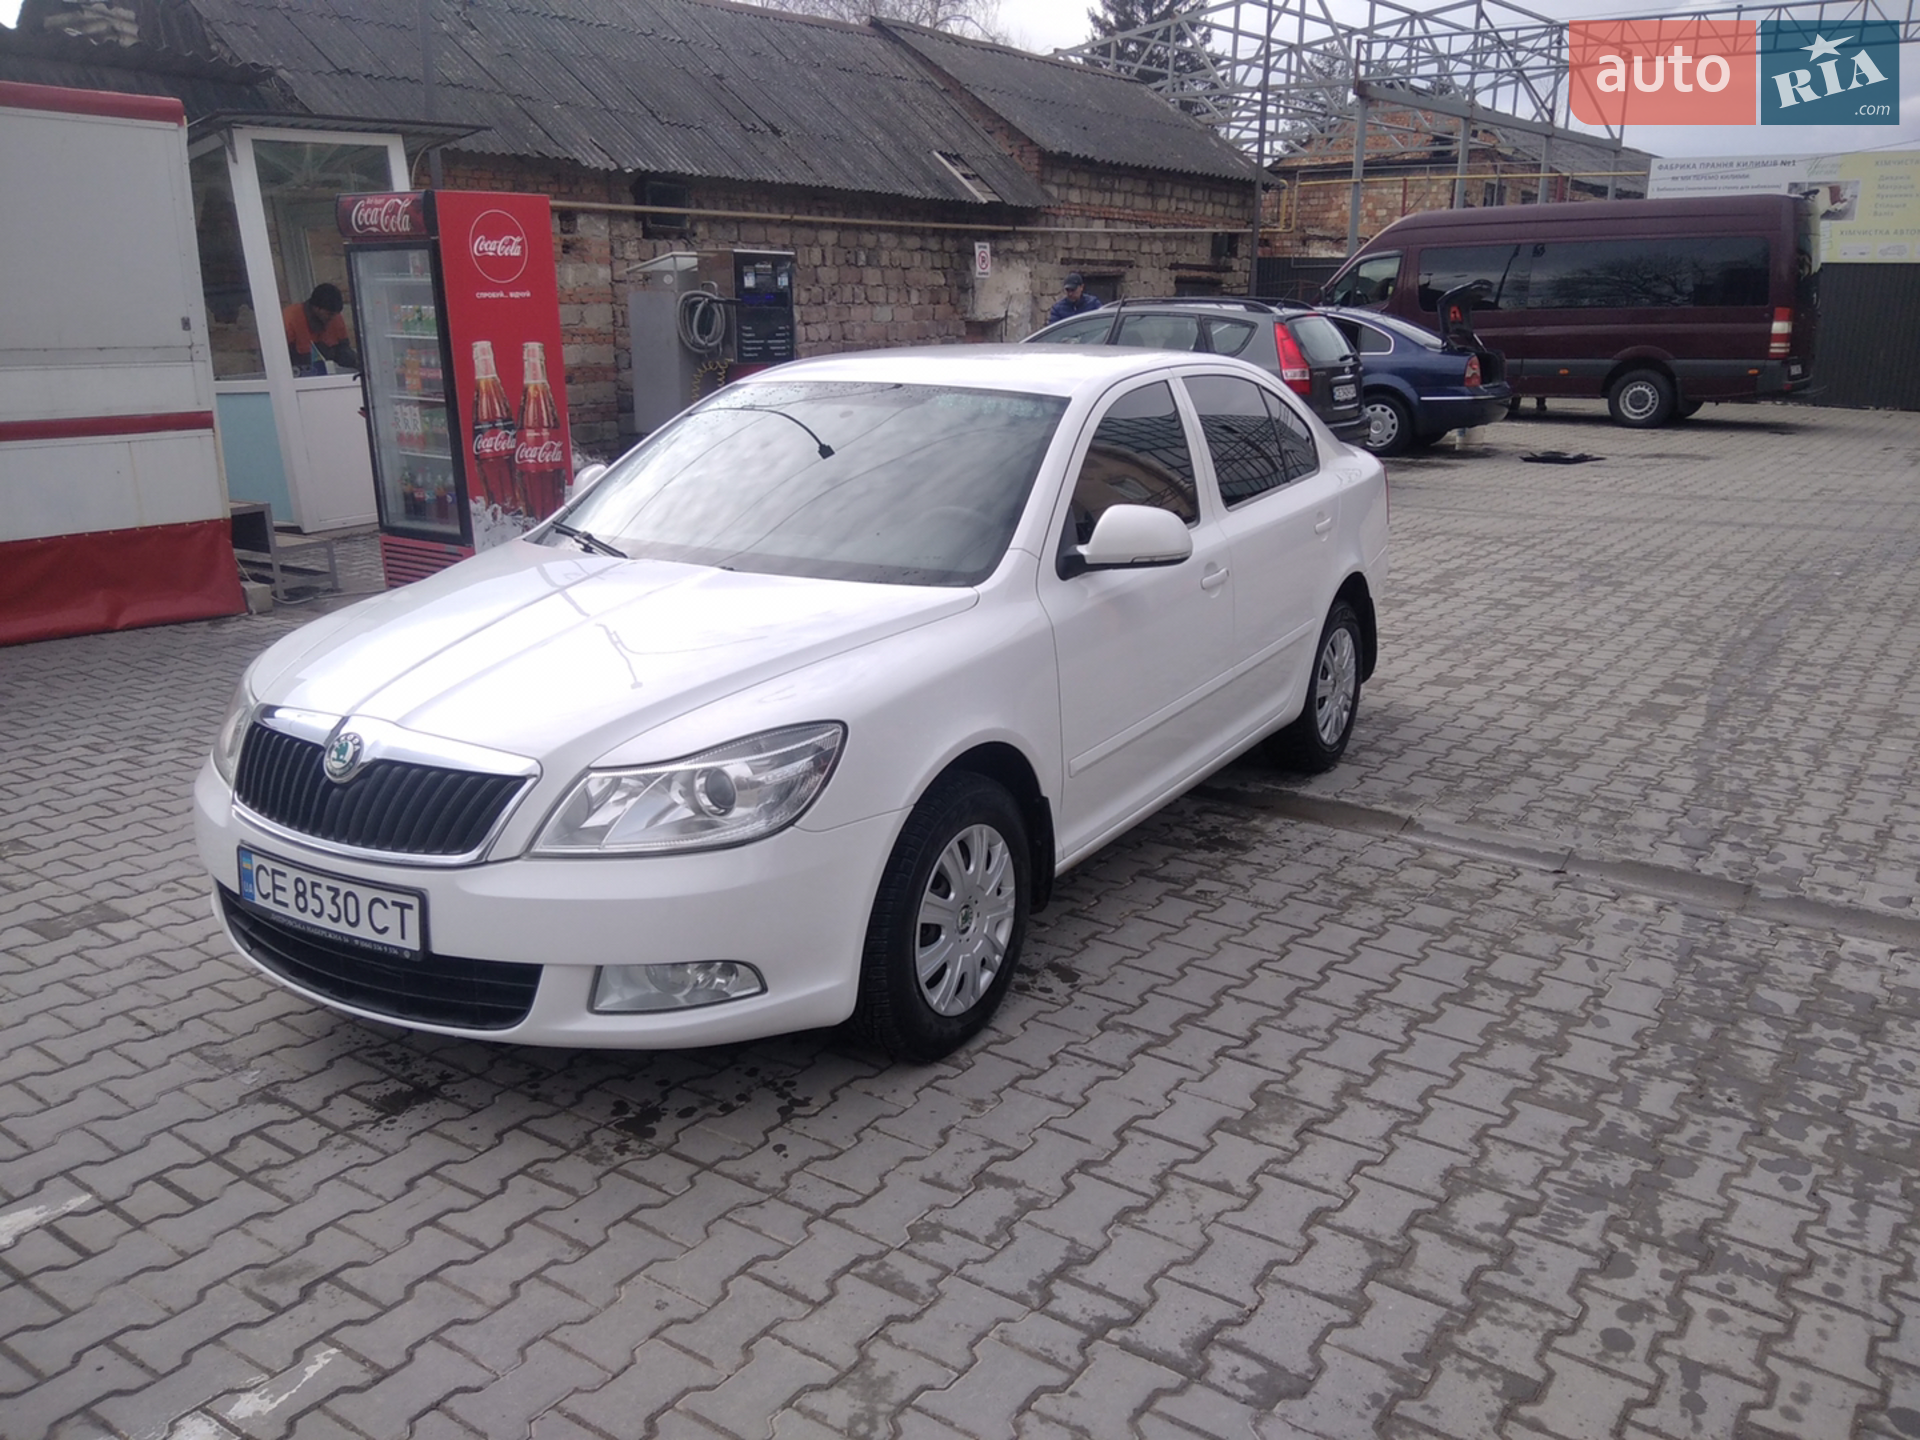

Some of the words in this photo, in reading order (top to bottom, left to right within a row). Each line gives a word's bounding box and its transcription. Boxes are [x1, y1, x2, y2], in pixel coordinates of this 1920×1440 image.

[1657, 162, 1697, 171] ФАБРИКА
[1700, 161, 1734, 169] ПРАННЯ
[473, 235, 523, 256] Coca-Cola
[515, 440, 563, 464] Coca-Cola
[255, 863, 289, 909] CE
[293, 876, 360, 928] 8530
[367, 896, 414, 941] CT
